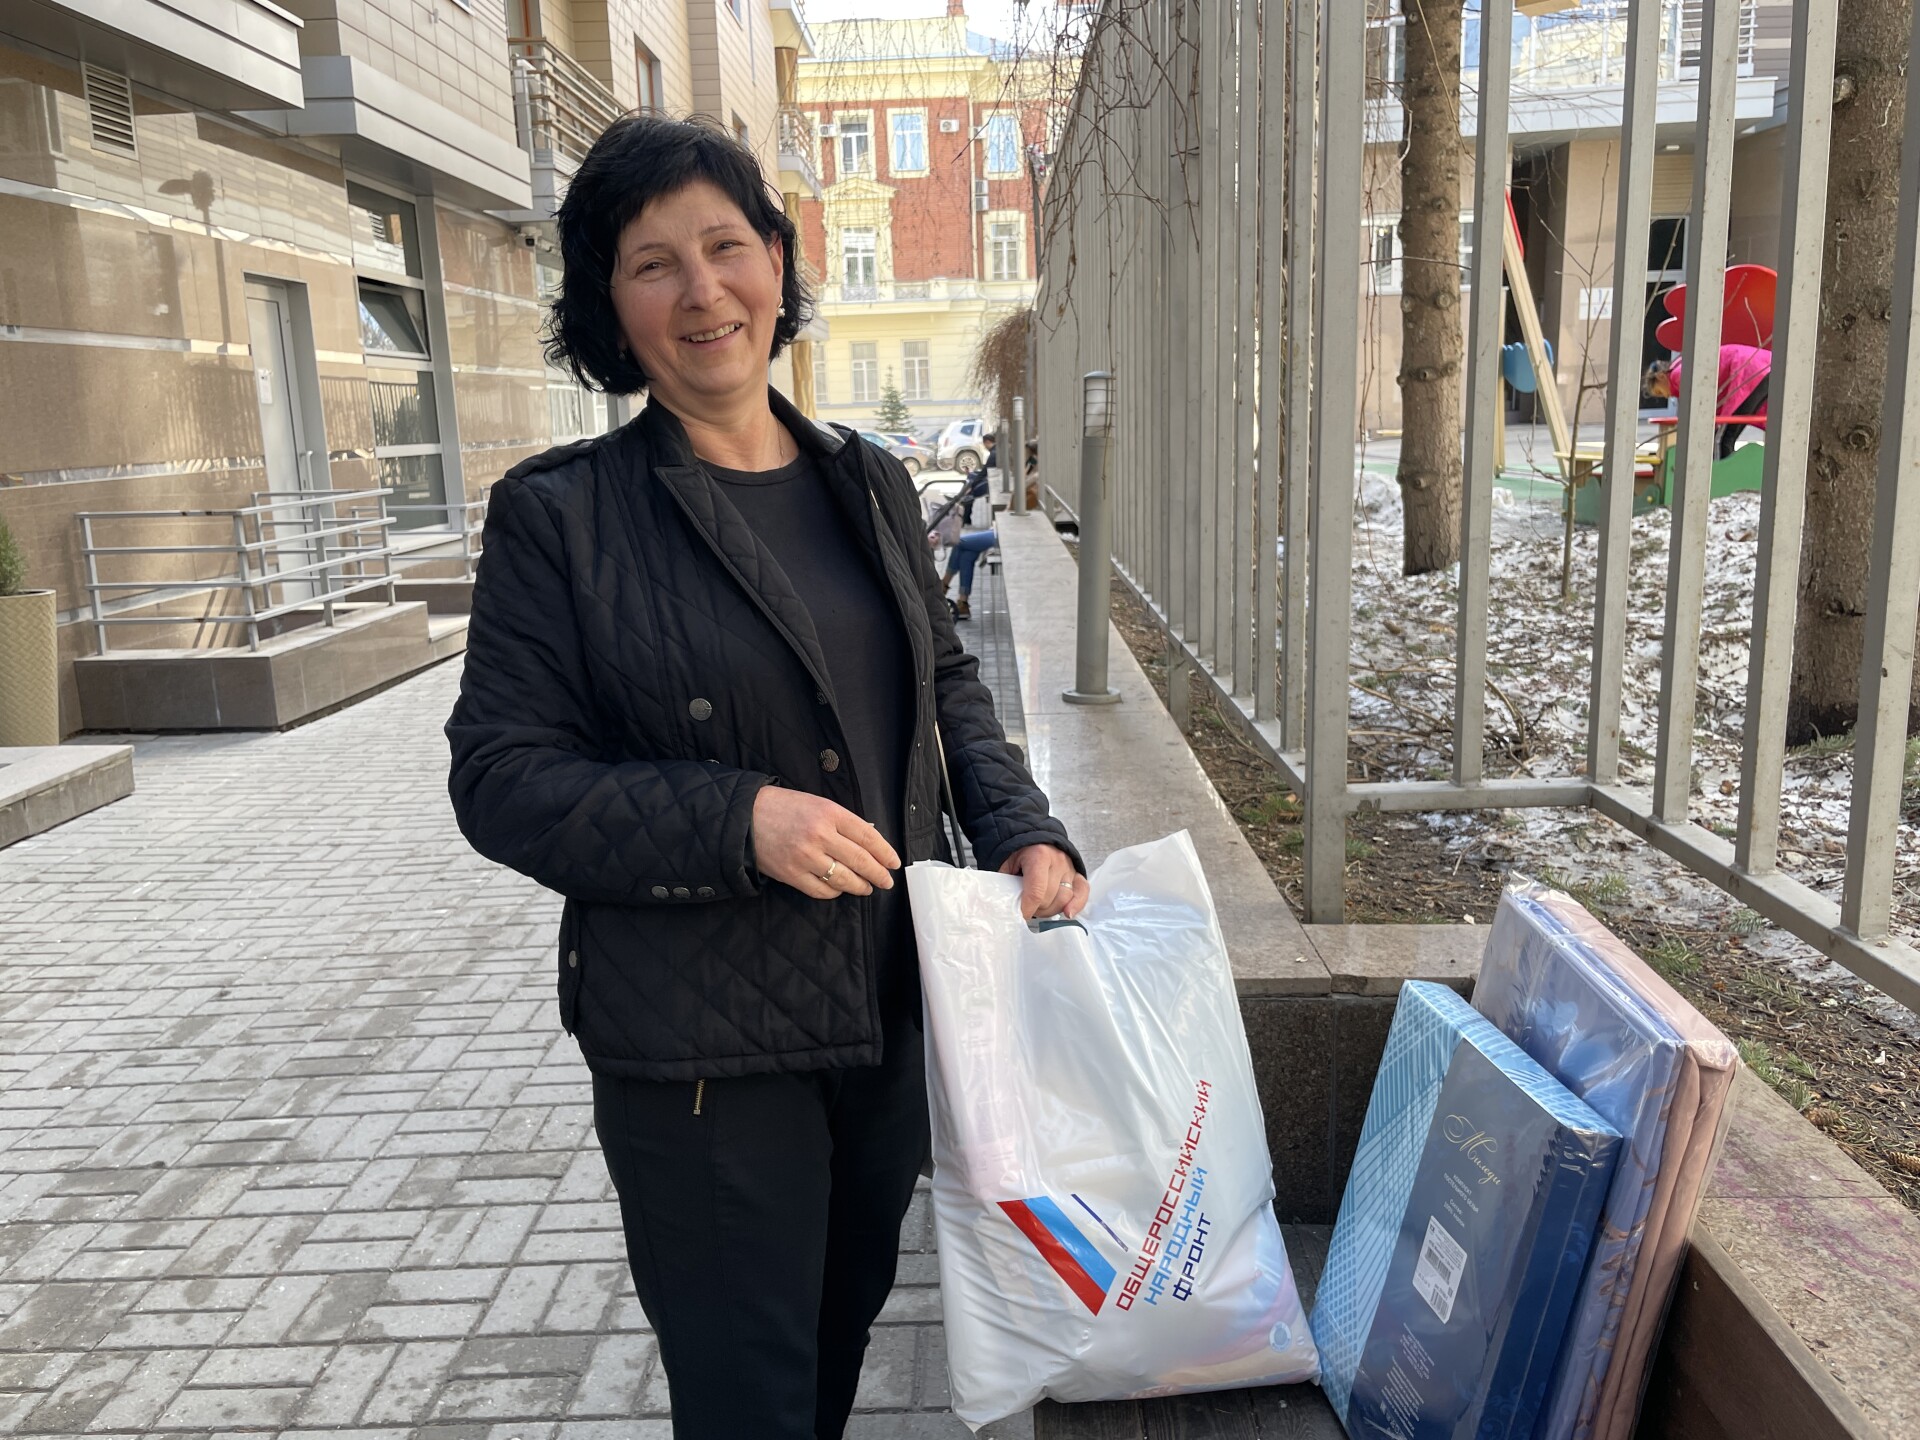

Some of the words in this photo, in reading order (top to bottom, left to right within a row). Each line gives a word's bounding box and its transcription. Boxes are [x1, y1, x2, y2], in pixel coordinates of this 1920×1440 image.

[1115, 1079, 1212, 1312] ОБЩЕРОССИЙСКИЙ
[1143, 1167, 1208, 1306] НАРОДНЫЙ
[1172, 1212, 1211, 1302] ФРОНТ
